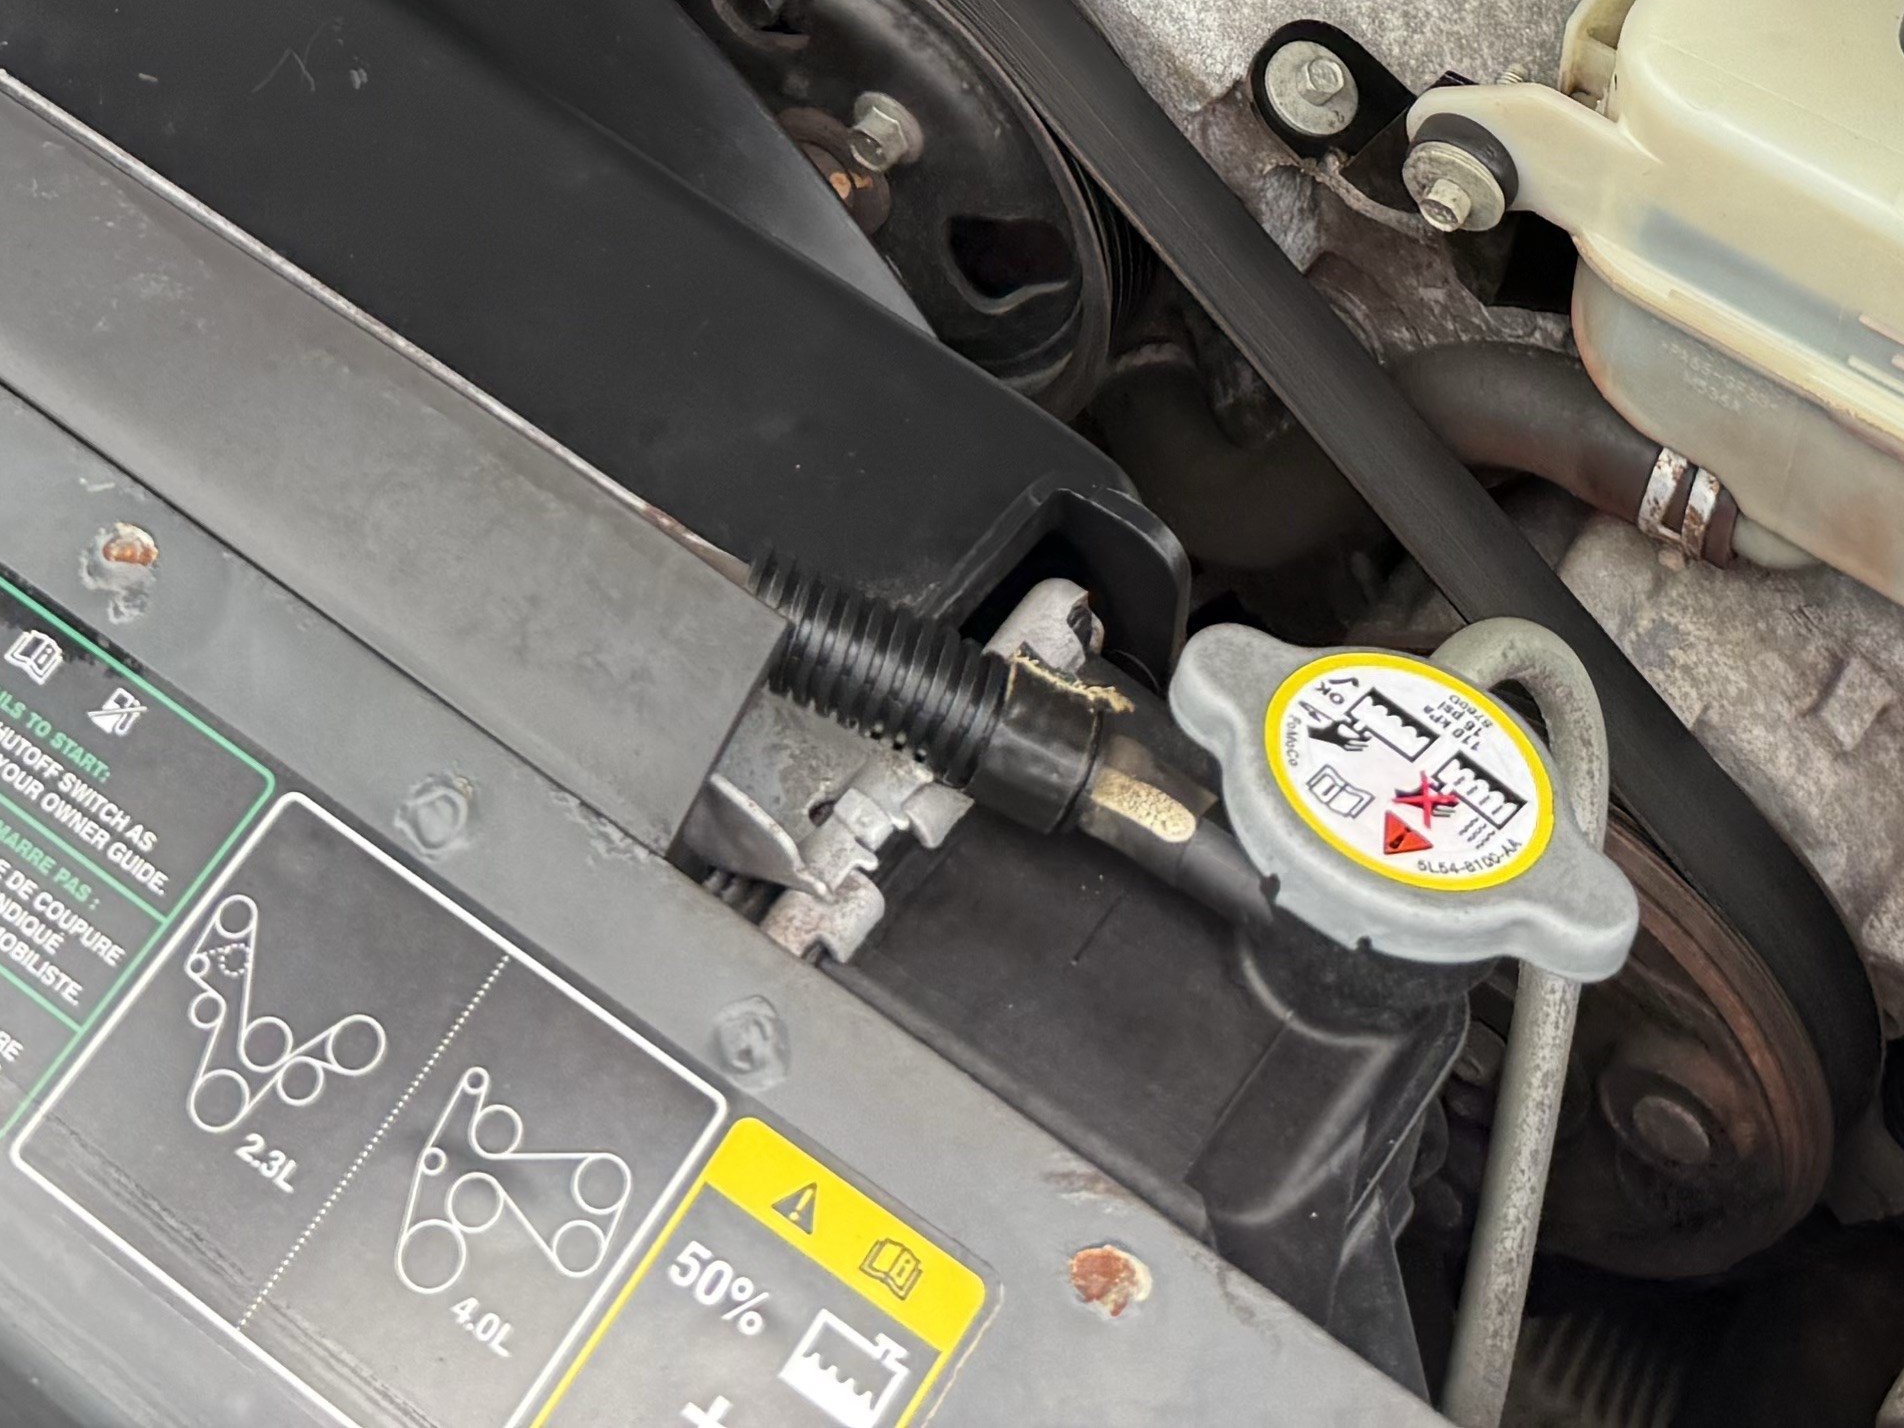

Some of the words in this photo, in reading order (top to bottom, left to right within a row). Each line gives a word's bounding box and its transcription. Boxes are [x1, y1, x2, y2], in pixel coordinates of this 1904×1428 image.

[1314, 680, 1345, 706] OK
[1437, 697, 1465, 722] psi
[21, 710, 55, 741] TO
[45, 728, 114, 785] START:
[1451, 725, 1481, 751] 110
[1463, 718, 1484, 737] 16
[37, 789, 113, 852] OWNER
[103, 838, 173, 898] GUIDE.
[55, 769, 132, 834] SWITCH
[122, 819, 160, 854] AS
[2, 868, 39, 902] DE
[29, 888, 126, 969] COUPURE
[235, 1133, 300, 1196] 2.3L
[669, 1240, 769, 1336] 50%
[449, 1292, 515, 1358] 4.0L
